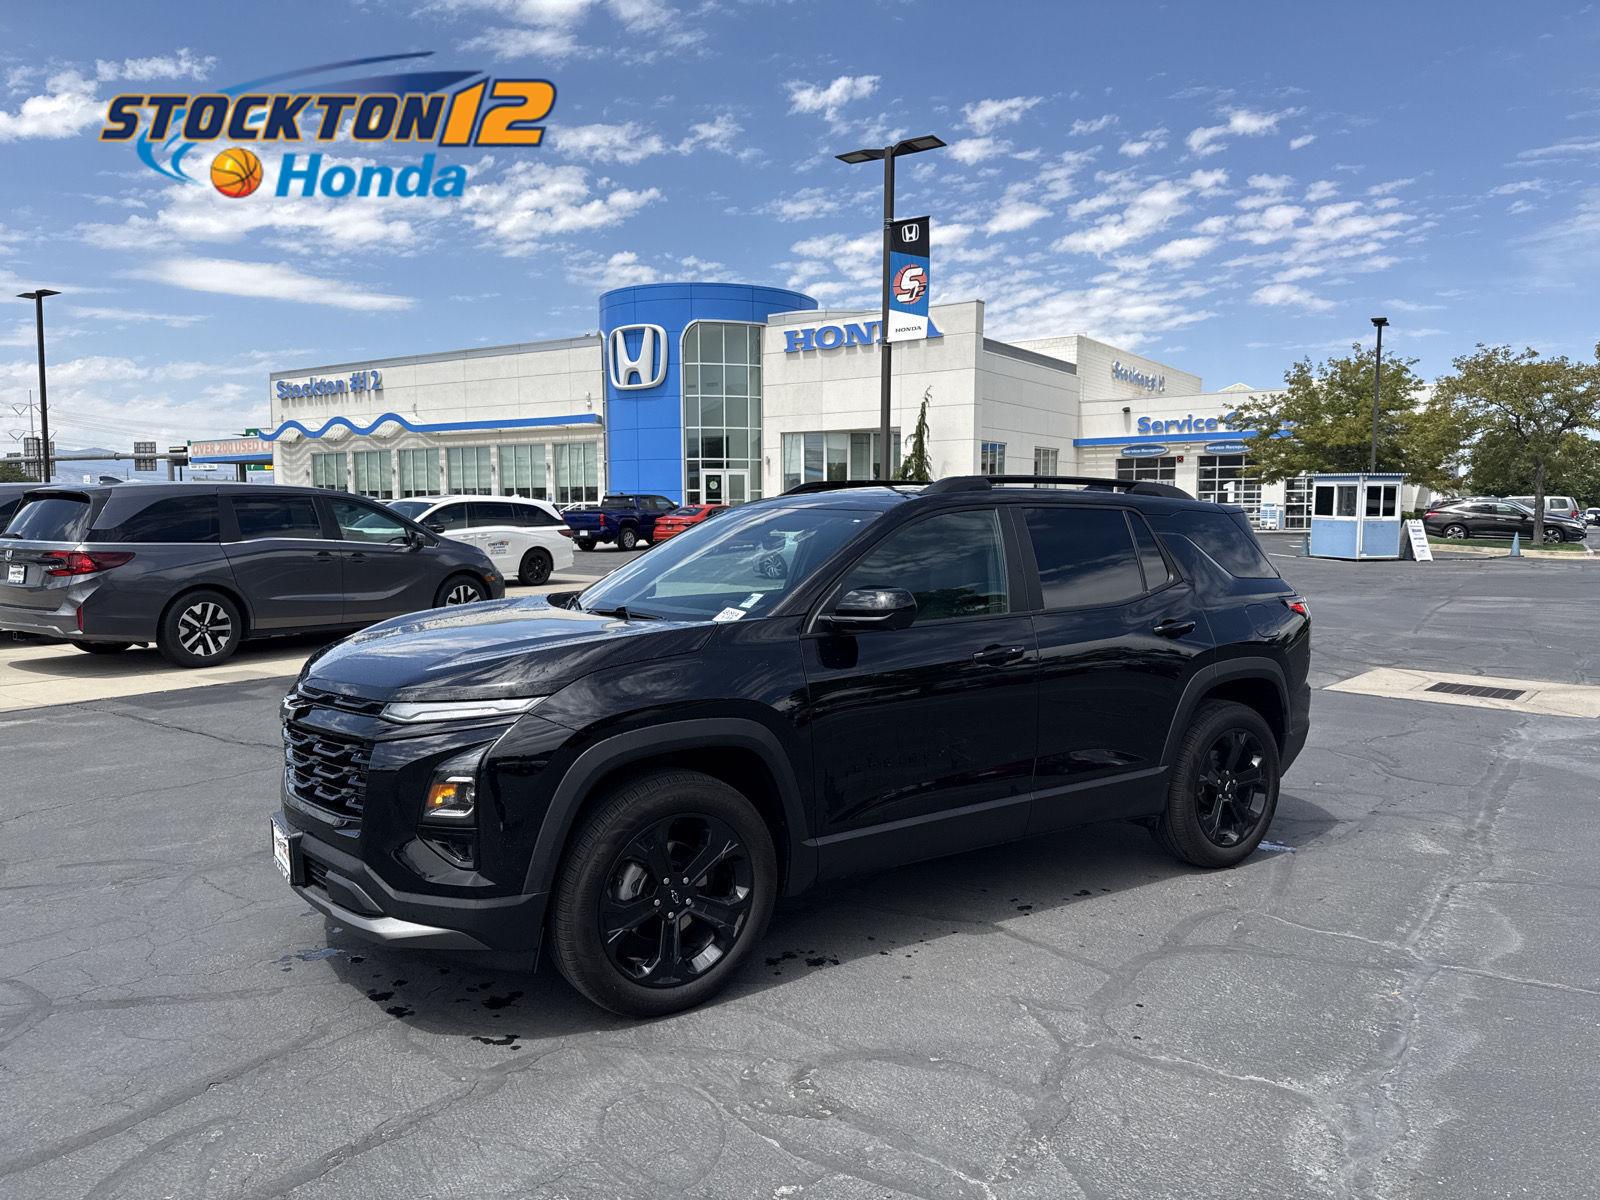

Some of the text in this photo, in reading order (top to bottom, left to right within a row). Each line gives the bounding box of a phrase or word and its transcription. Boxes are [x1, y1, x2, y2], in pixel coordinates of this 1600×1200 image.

[784, 317, 944, 352] HON
[895, 325, 922, 333] HONDA
[275, 370, 383, 399] Stockton #12
[1137, 414, 1219, 434] Service
[192, 442, 215, 456] OVER
[217, 441, 234, 454] 200
[235, 440, 260, 452] USED
[1223, 481, 1235, 503] 1
